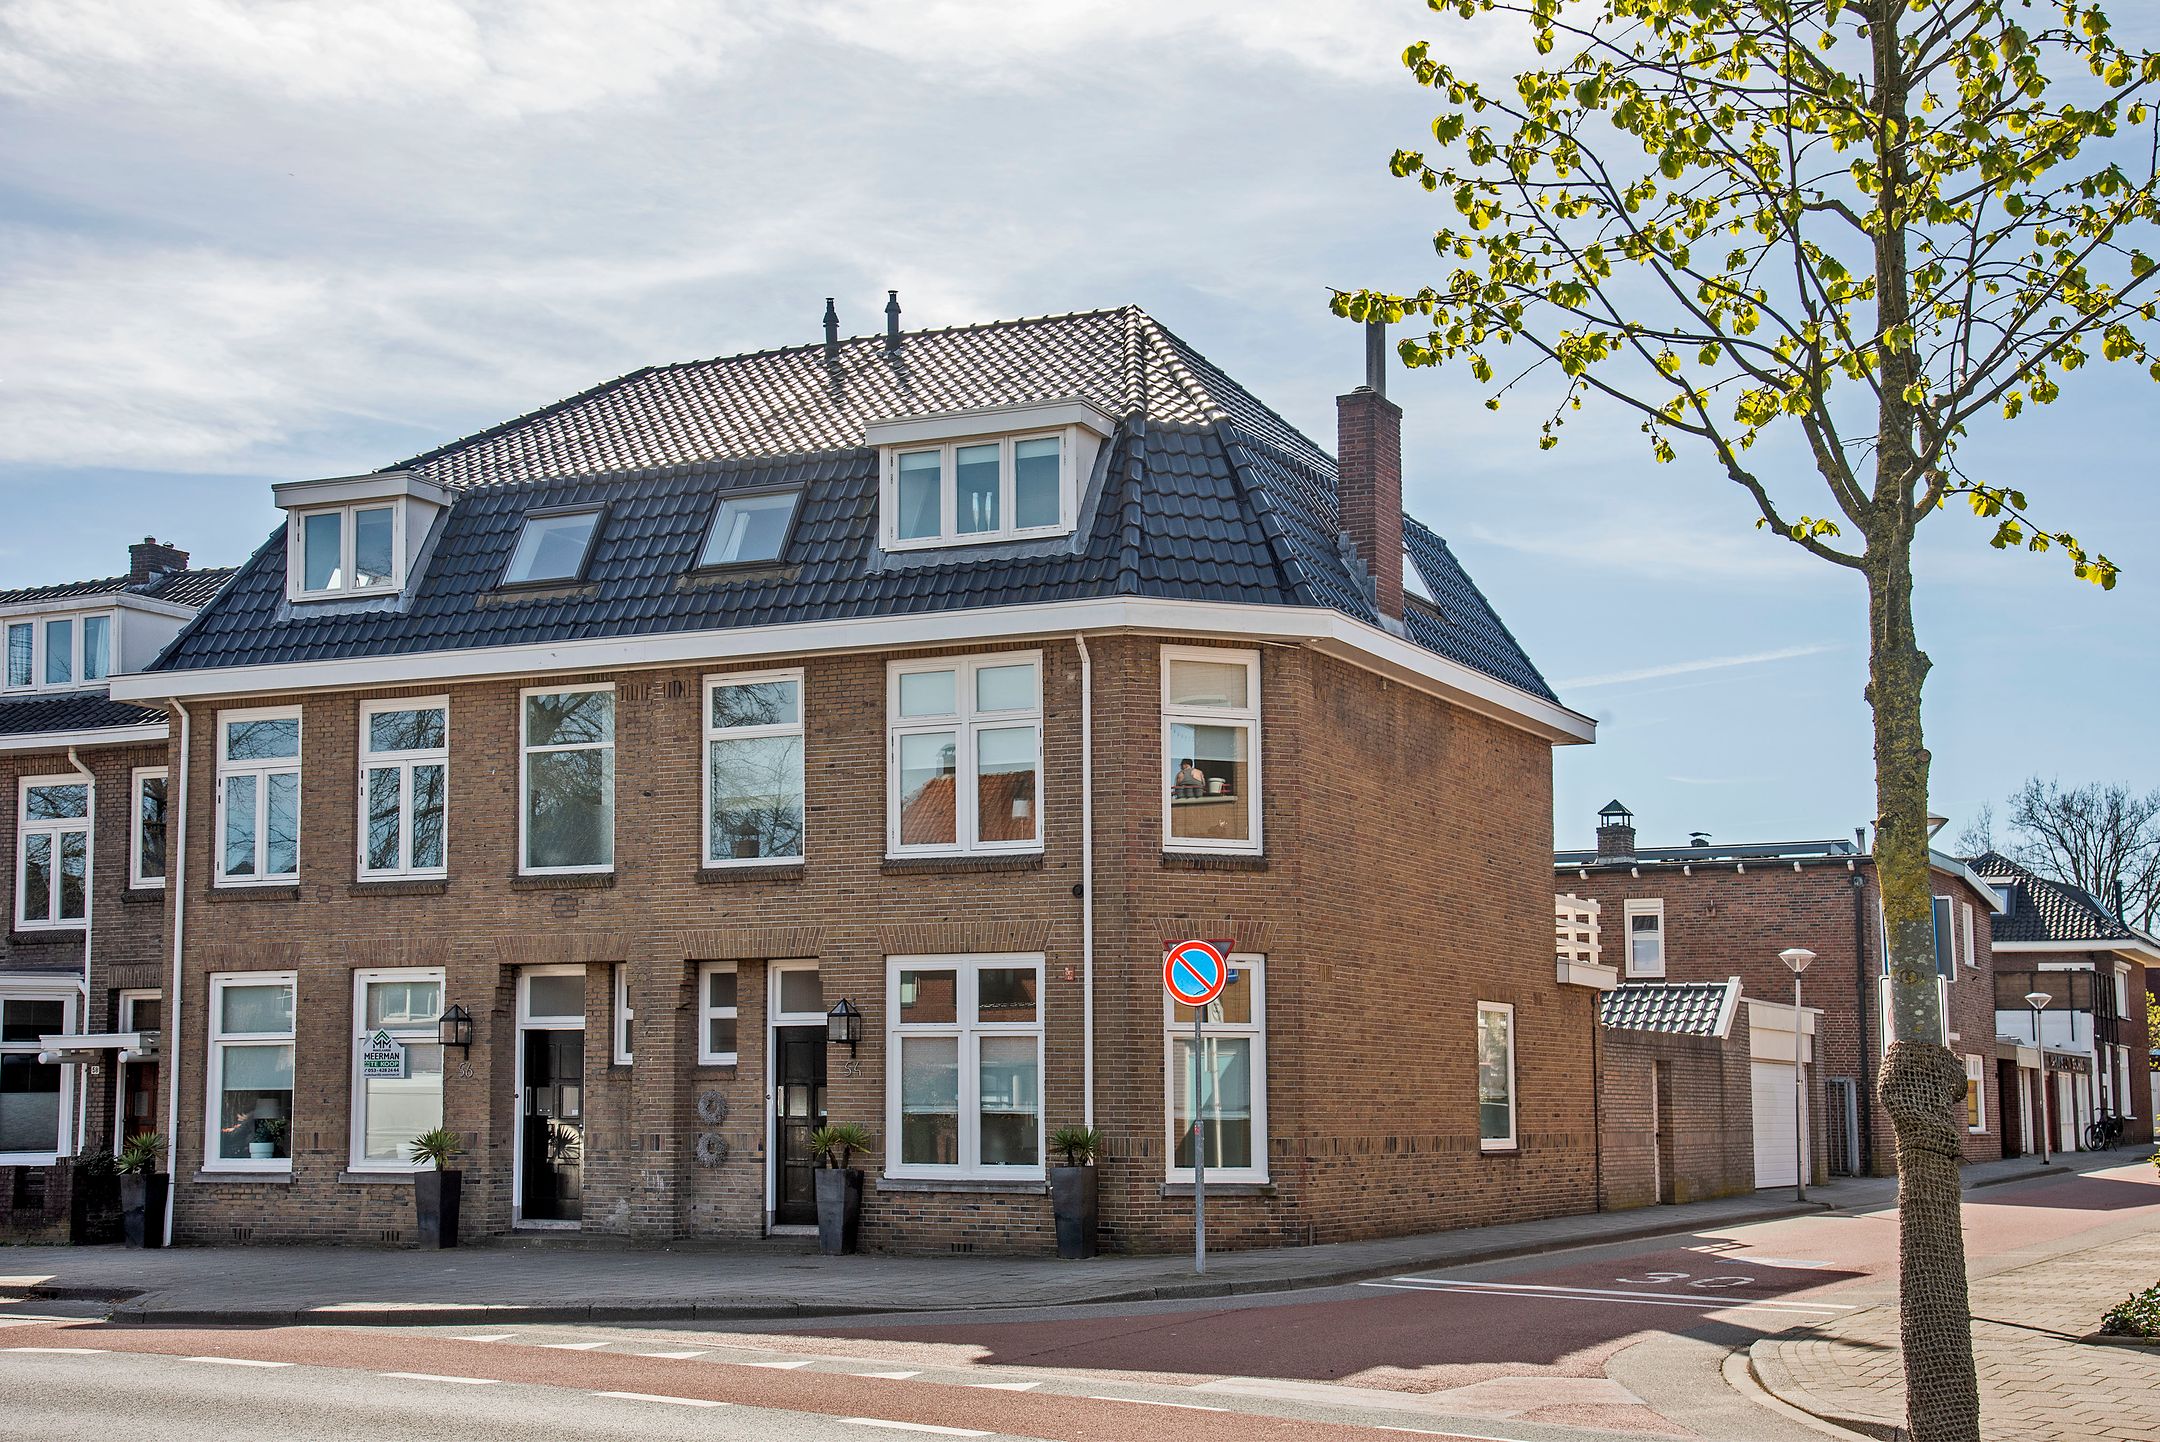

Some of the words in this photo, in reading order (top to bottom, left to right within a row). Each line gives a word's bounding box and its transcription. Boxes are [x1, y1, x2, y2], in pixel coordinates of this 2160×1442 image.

[459, 1062, 474, 1078] 56
[844, 1061, 862, 1077] 54
[1615, 1272, 1755, 1288] 30
